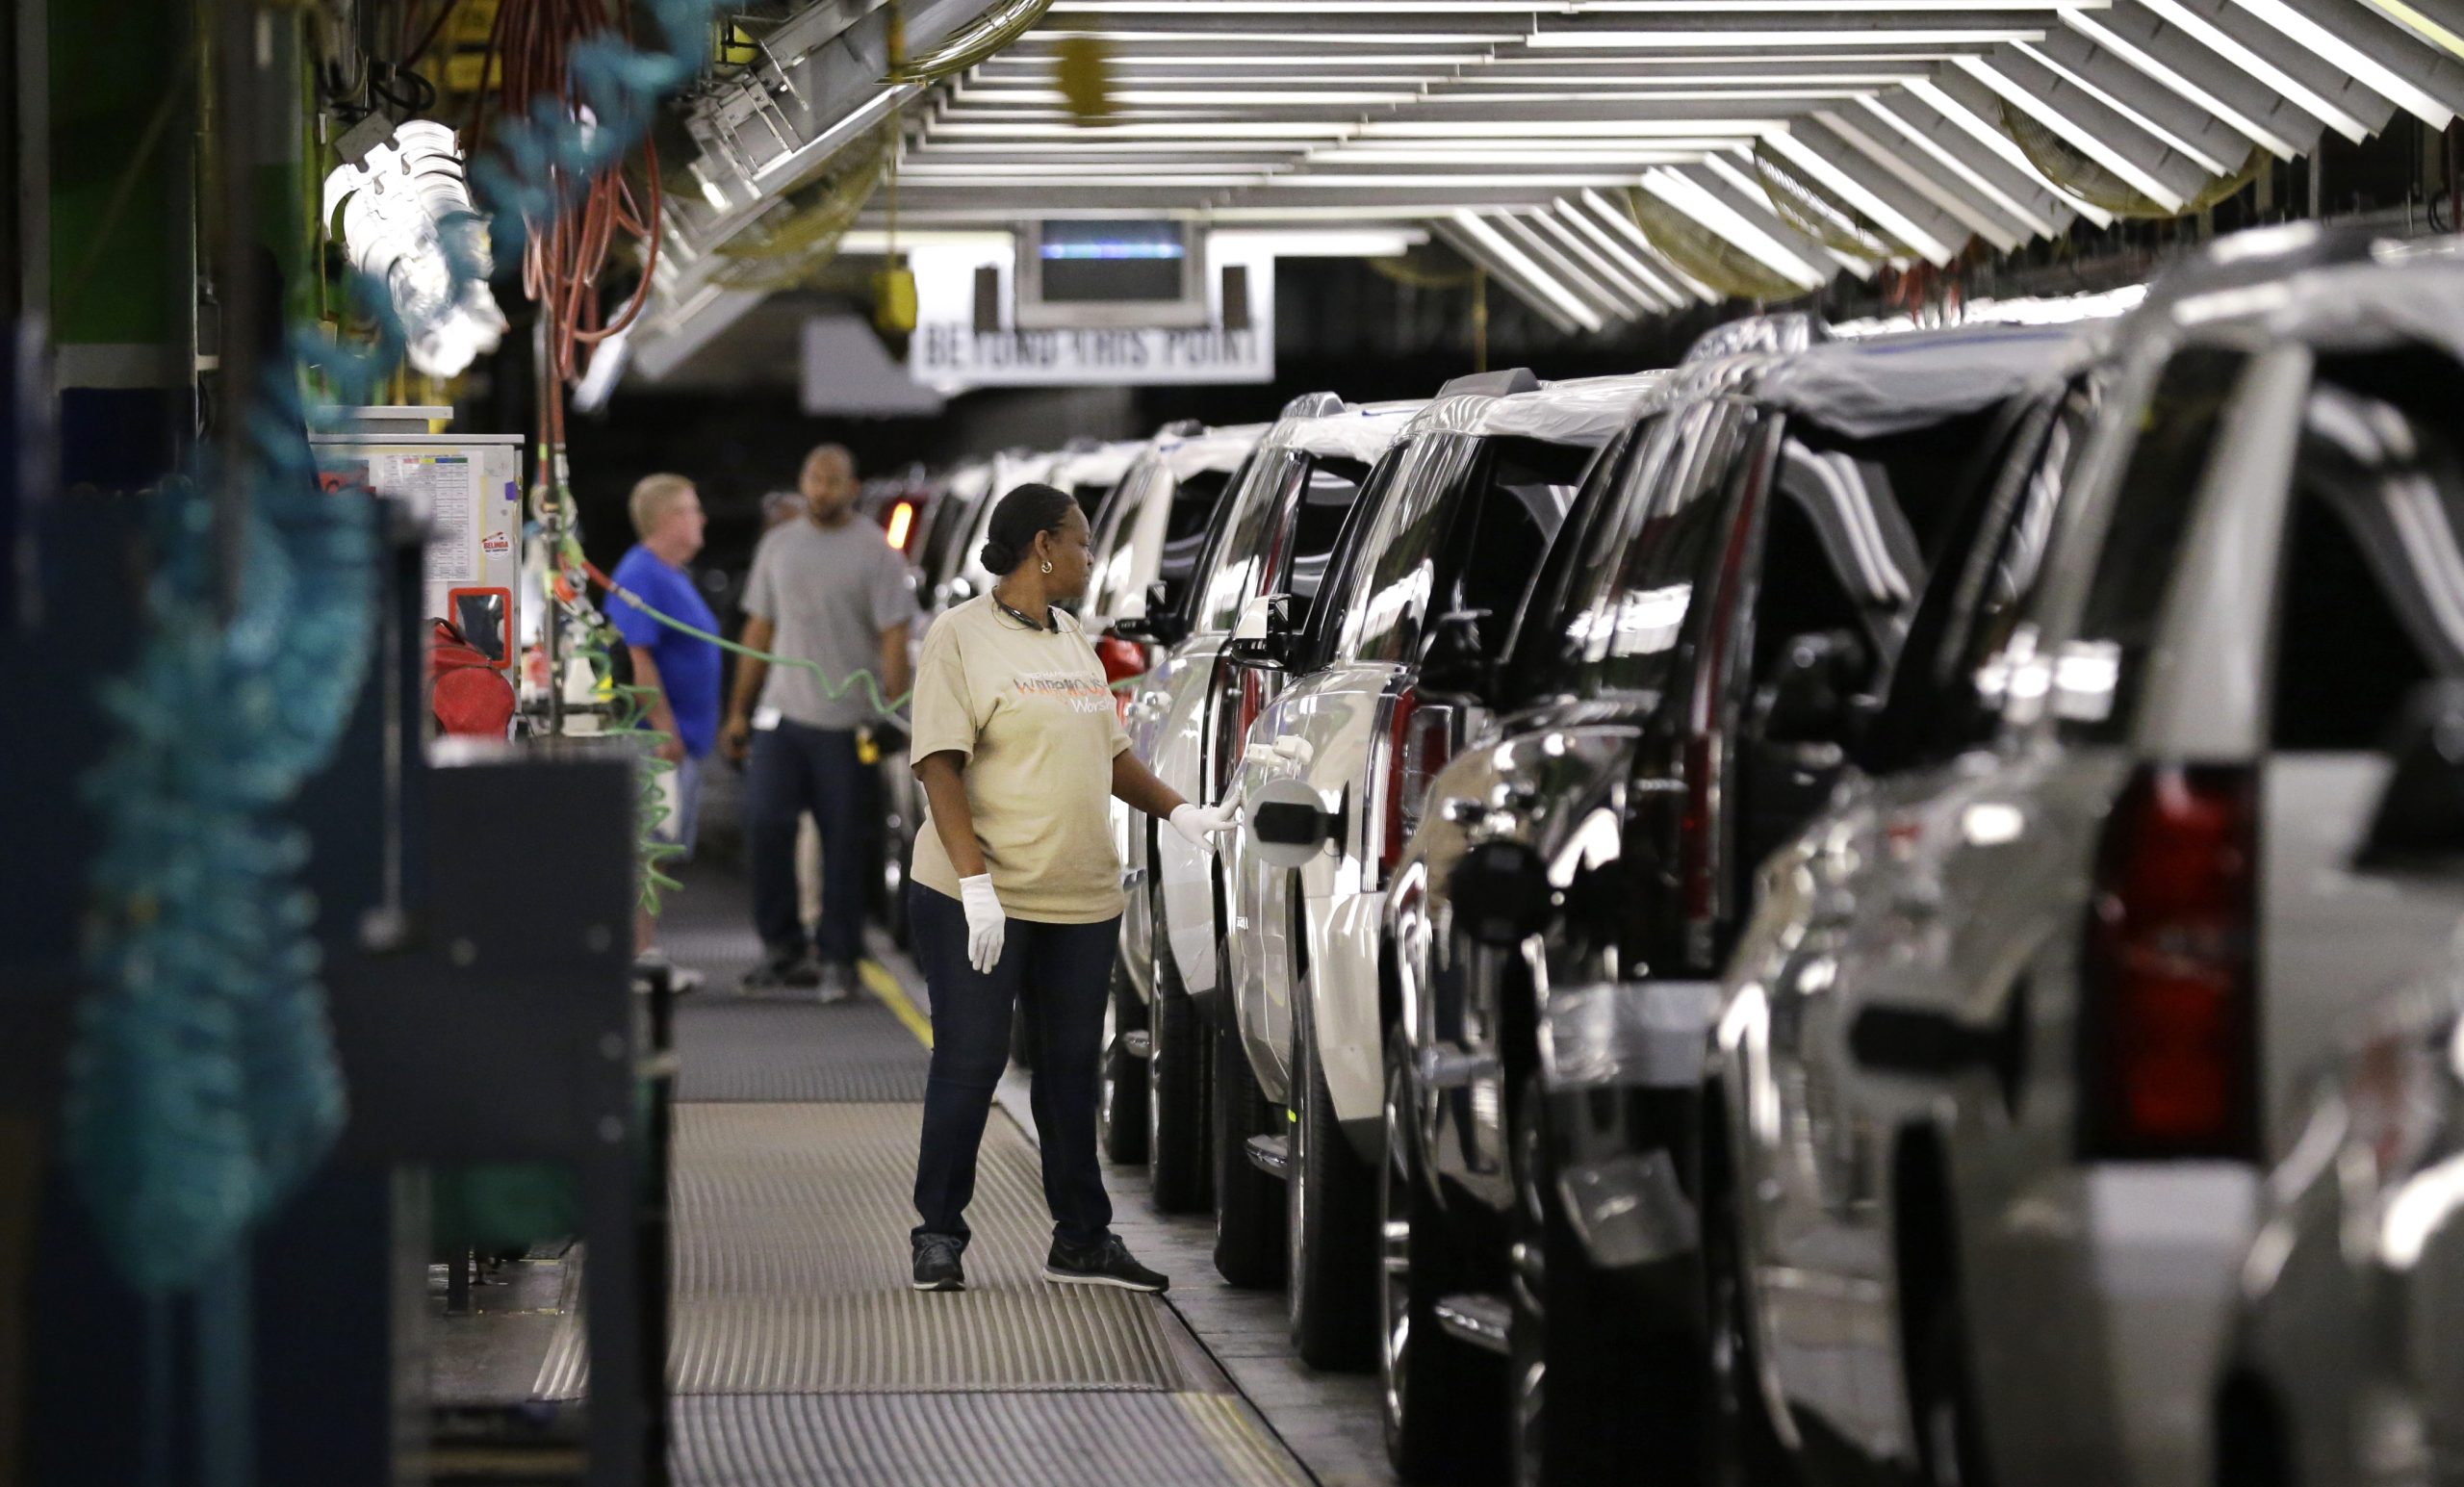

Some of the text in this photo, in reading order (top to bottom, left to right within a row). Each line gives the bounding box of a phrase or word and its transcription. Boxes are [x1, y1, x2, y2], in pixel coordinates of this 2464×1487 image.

[926, 323, 1258, 368] BEYOND THIS POINT
